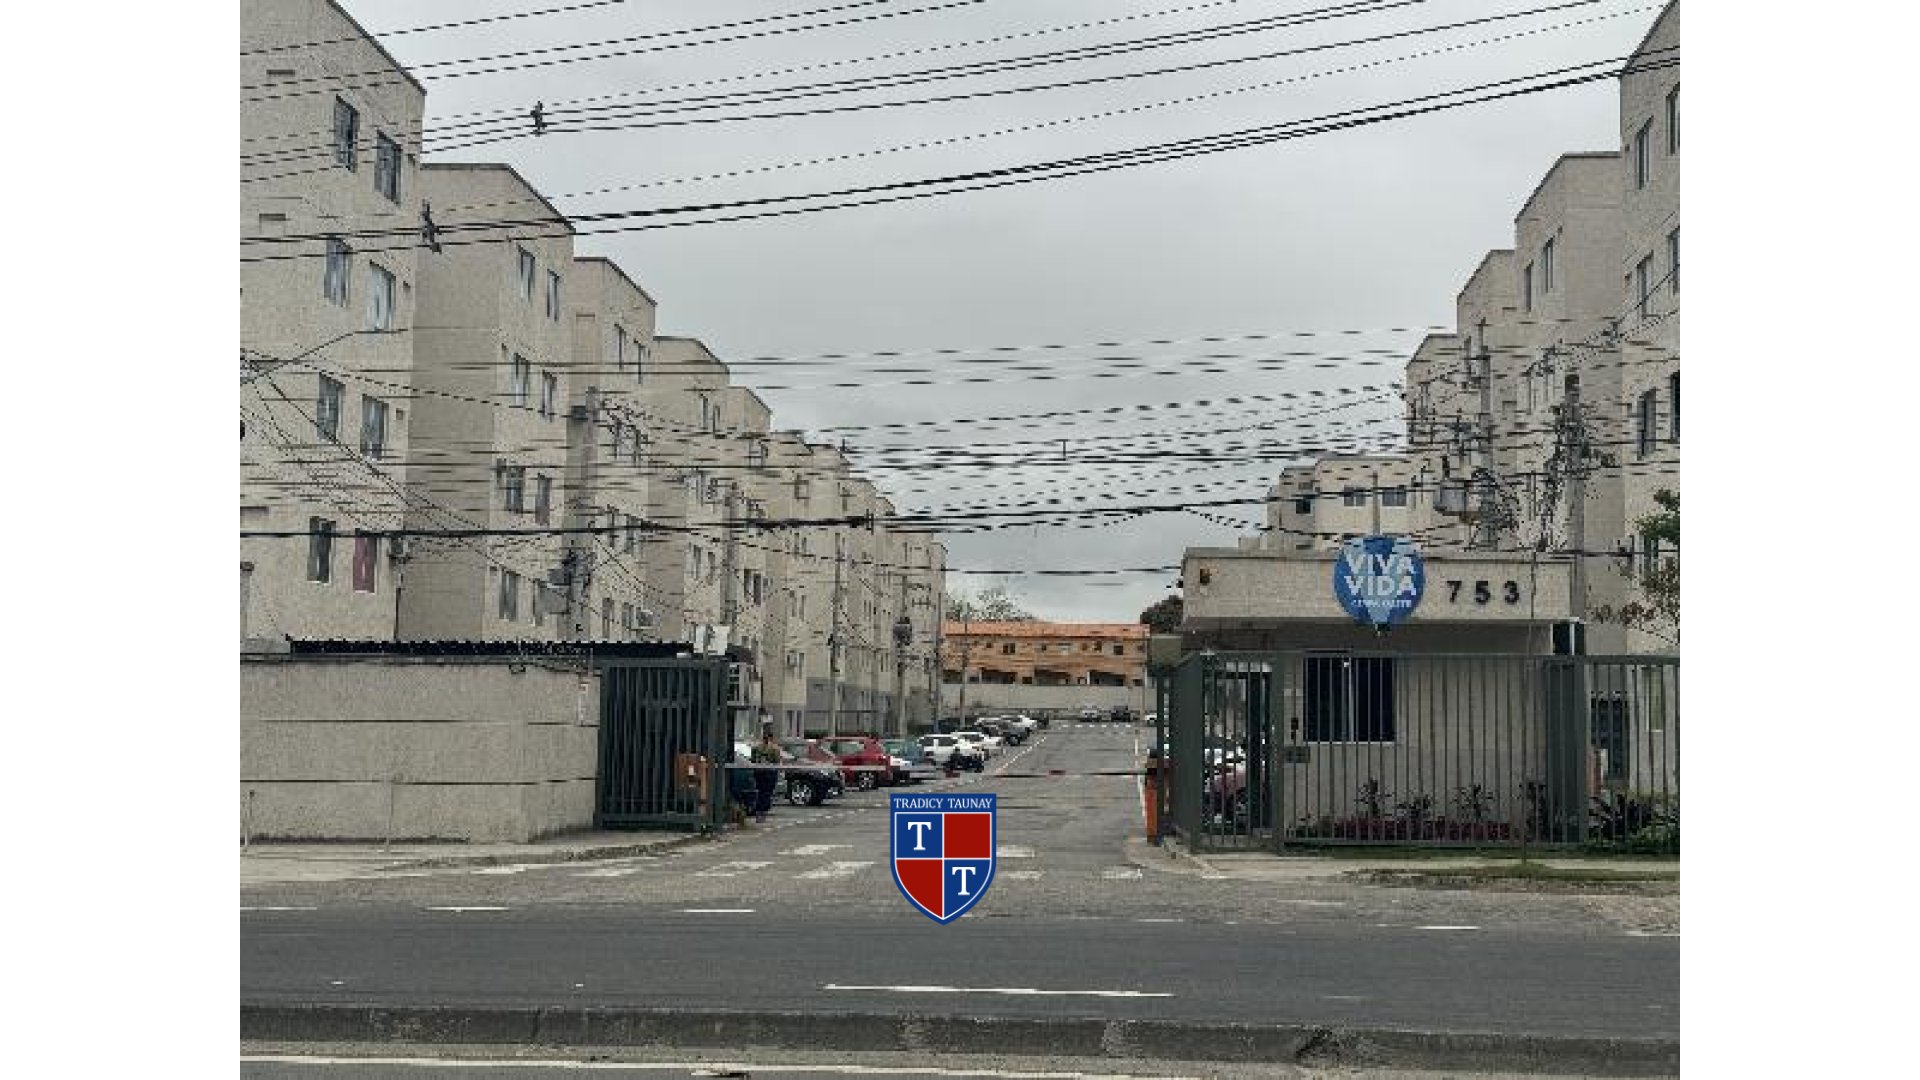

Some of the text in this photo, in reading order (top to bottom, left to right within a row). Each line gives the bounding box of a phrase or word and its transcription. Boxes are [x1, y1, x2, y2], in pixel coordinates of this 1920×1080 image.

[1345, 554, 1415, 574] VIVA
[1344, 575, 1417, 596] VIDA
[1447, 580, 1520, 605] 753
